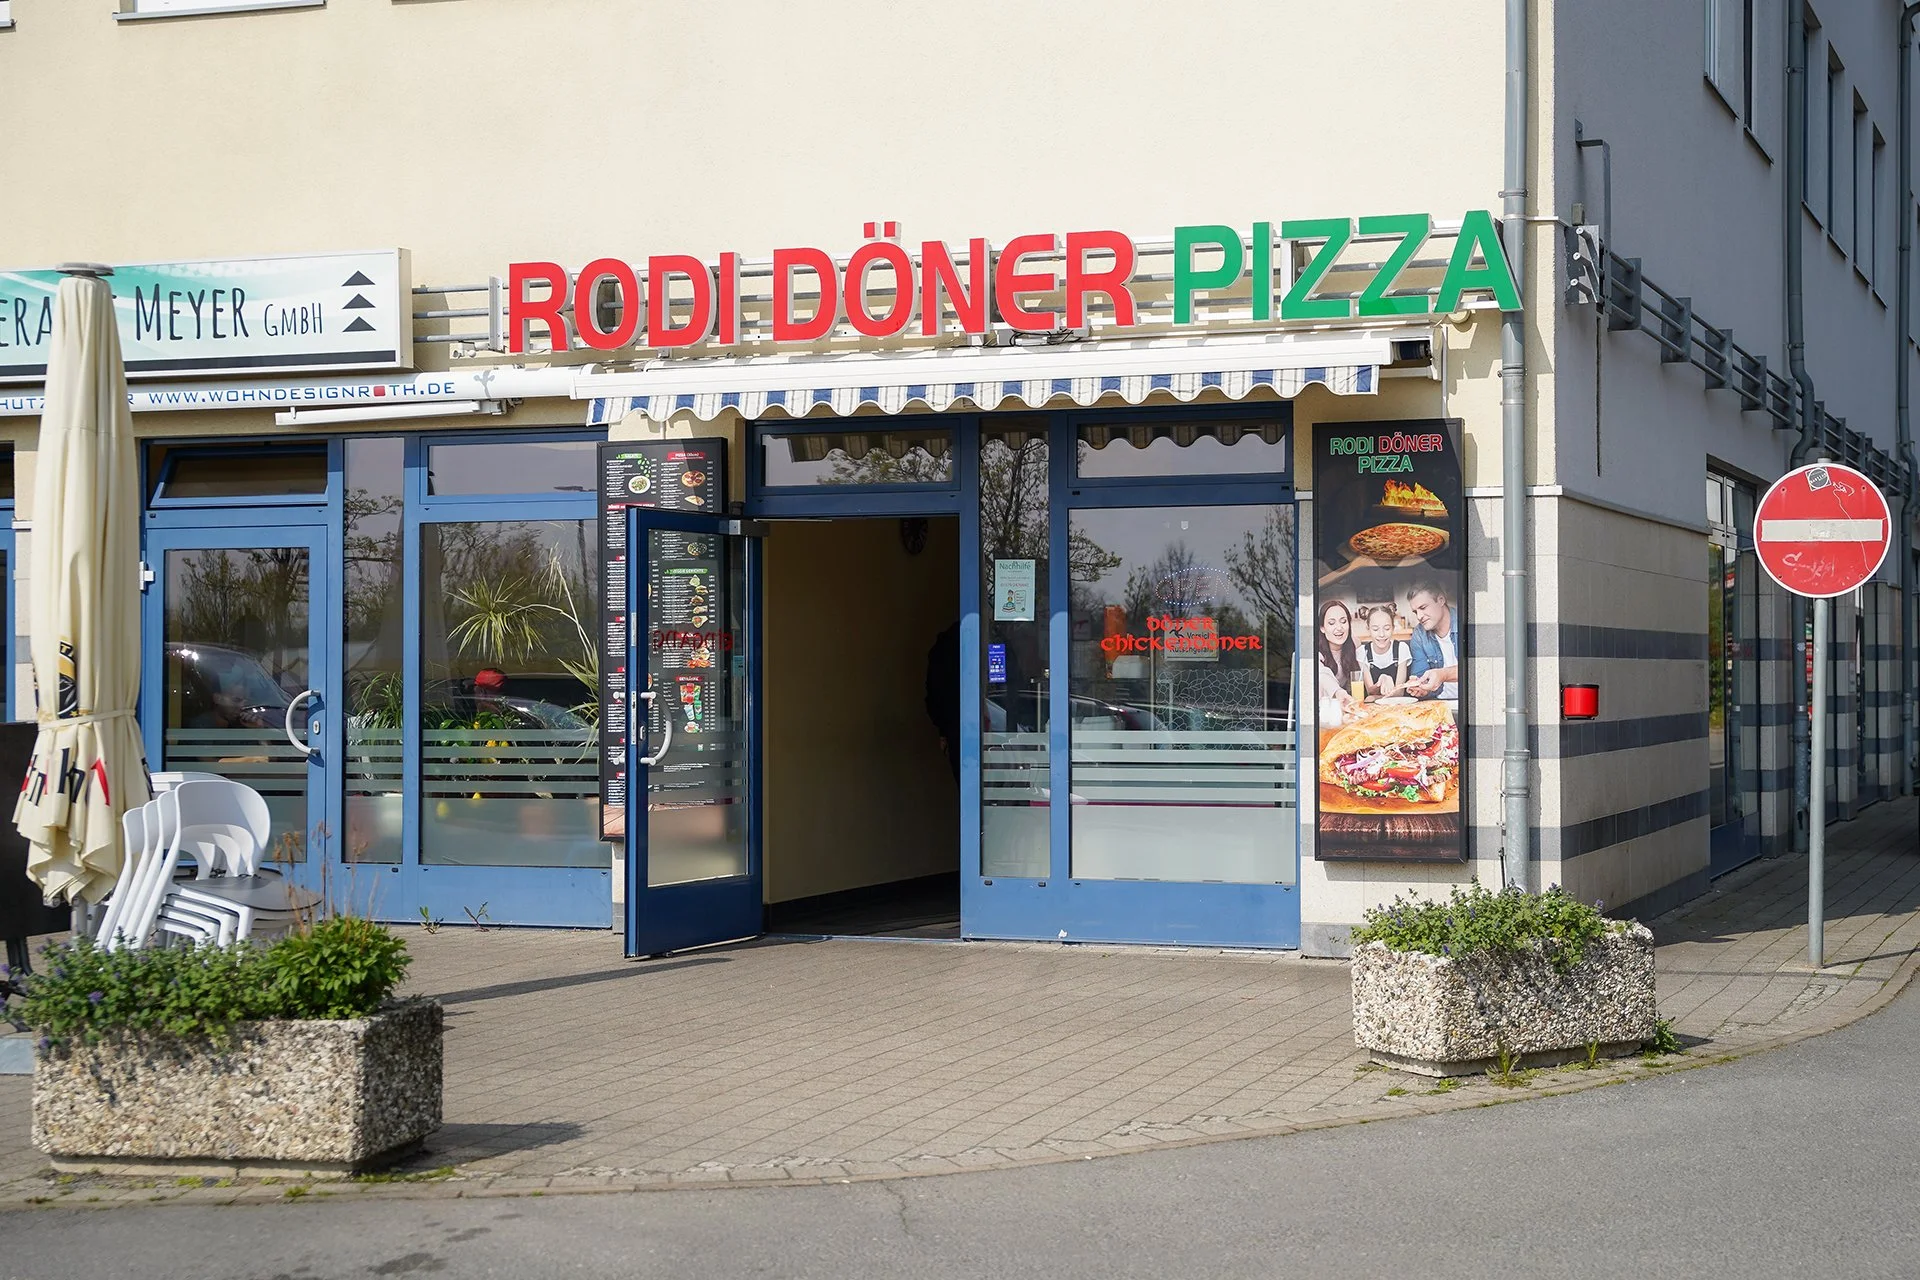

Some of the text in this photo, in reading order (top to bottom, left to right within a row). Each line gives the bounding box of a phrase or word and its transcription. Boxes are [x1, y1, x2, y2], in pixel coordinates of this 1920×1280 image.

[509, 210, 1524, 353] RODI DÖNER PIZZA
[135, 283, 249, 341] MEYER
[1330, 431, 1443, 455] RODI DÖNER
[1358, 454, 1414, 473] PIZZA
[1156, 575, 1232, 599] OPEN
